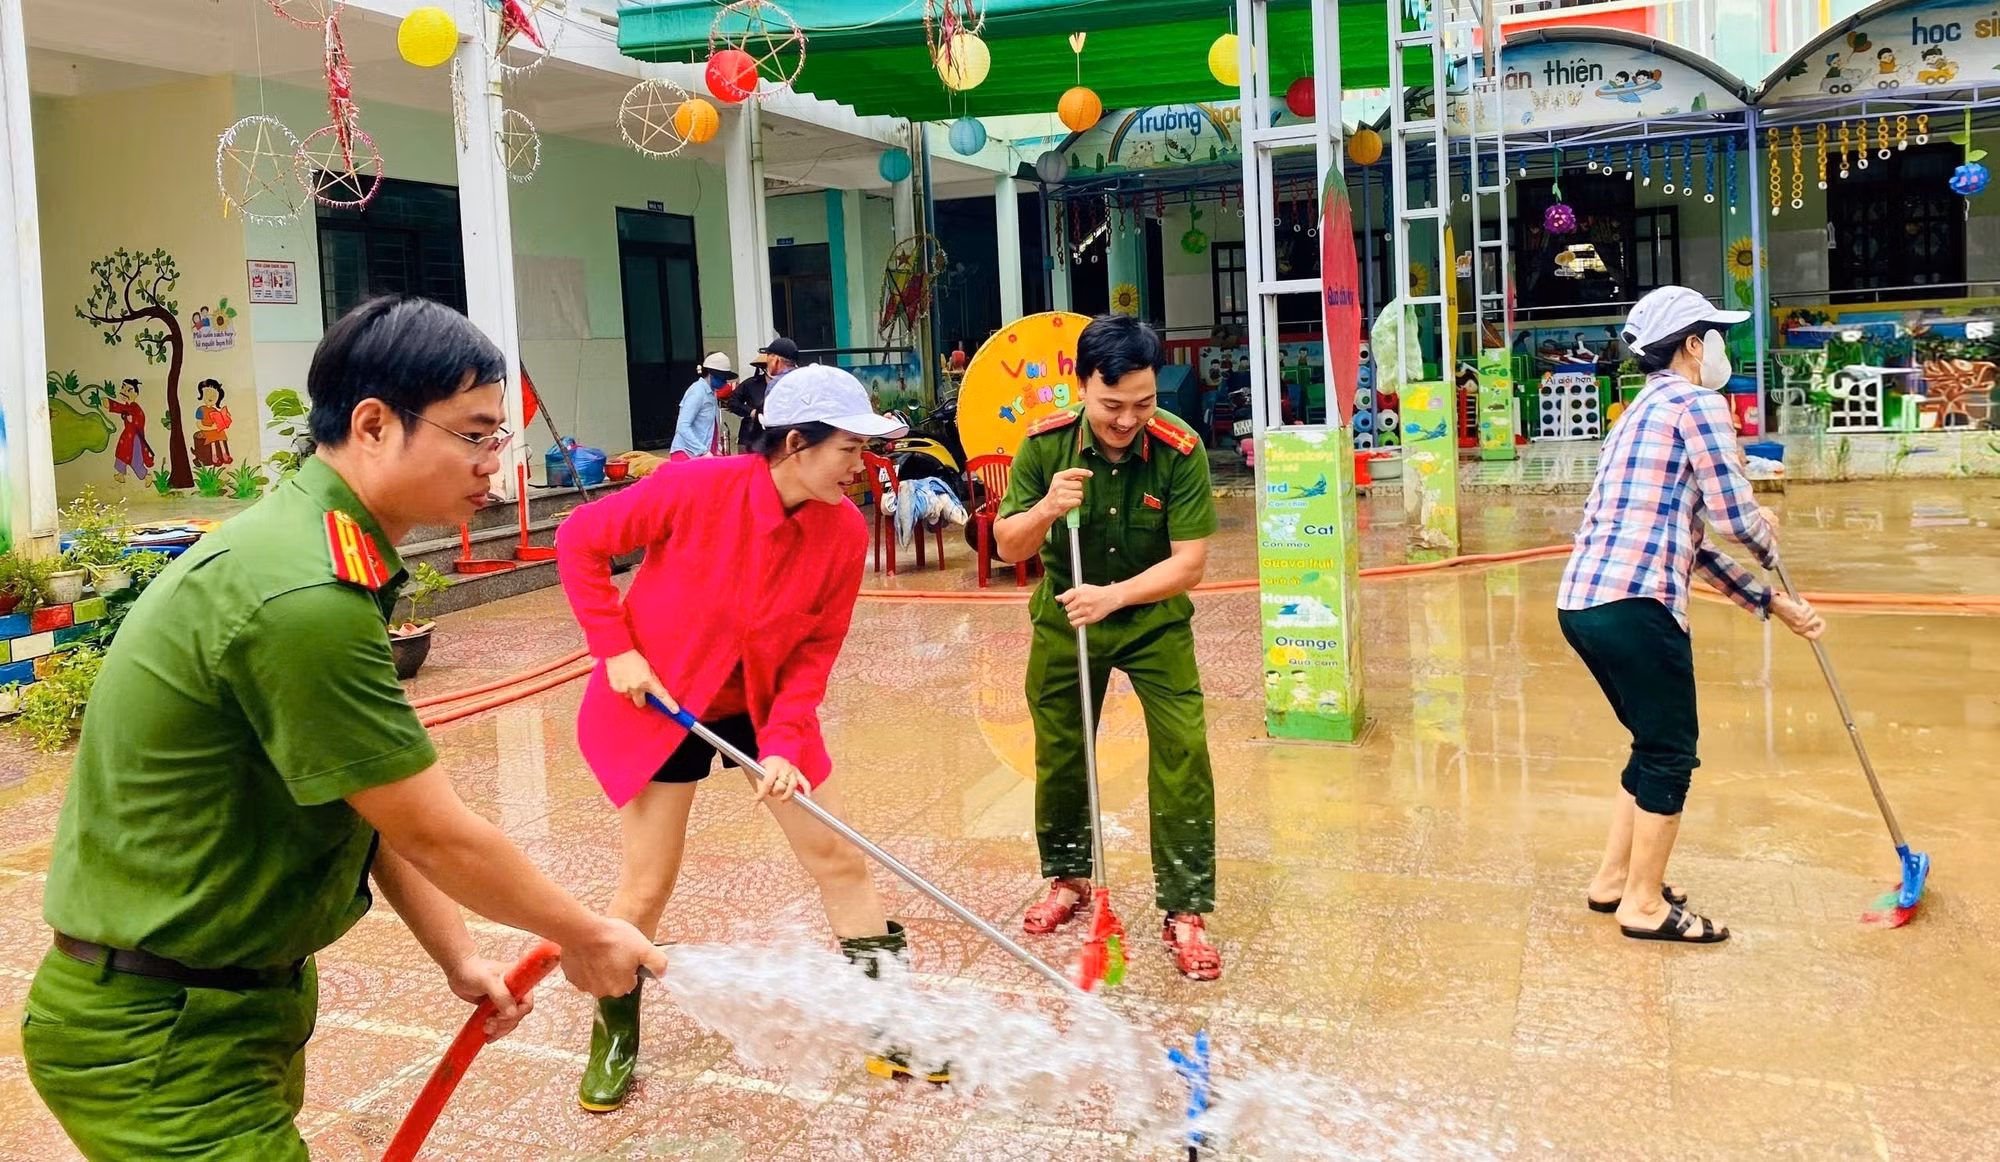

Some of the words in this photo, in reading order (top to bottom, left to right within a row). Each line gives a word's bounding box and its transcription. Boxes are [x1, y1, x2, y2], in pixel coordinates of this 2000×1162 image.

[1975, 10, 2000, 38] si
[1543, 57, 1603, 89] thiện
[1136, 106, 1202, 136] Trường
[1001, 358, 1047, 379] Vui
[999, 383, 1070, 423] trăng
[1303, 524, 1334, 535] Cat
[1262, 557, 1305, 569] Guava
[1275, 636, 1338, 651] Orange
